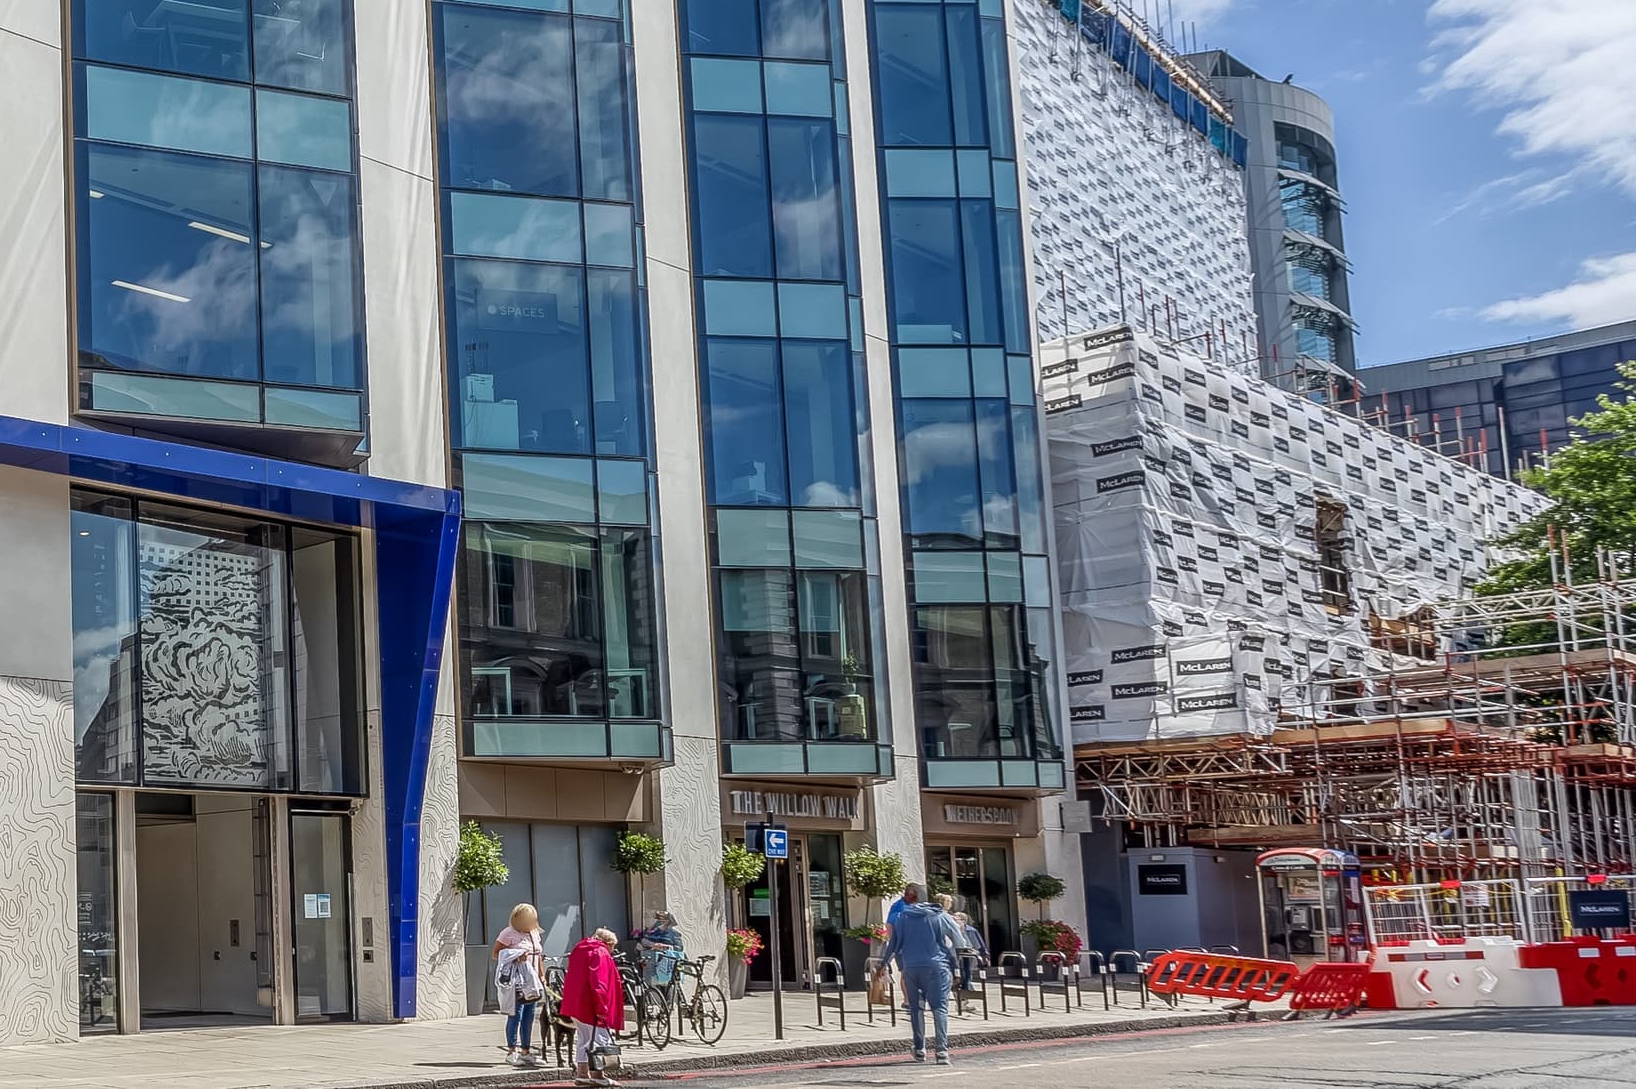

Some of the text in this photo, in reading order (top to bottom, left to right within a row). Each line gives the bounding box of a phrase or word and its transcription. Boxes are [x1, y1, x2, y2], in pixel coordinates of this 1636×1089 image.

[730, 791, 860, 819] THE WILLOW WALK
[945, 804, 1020, 825] WETHERSPOON
